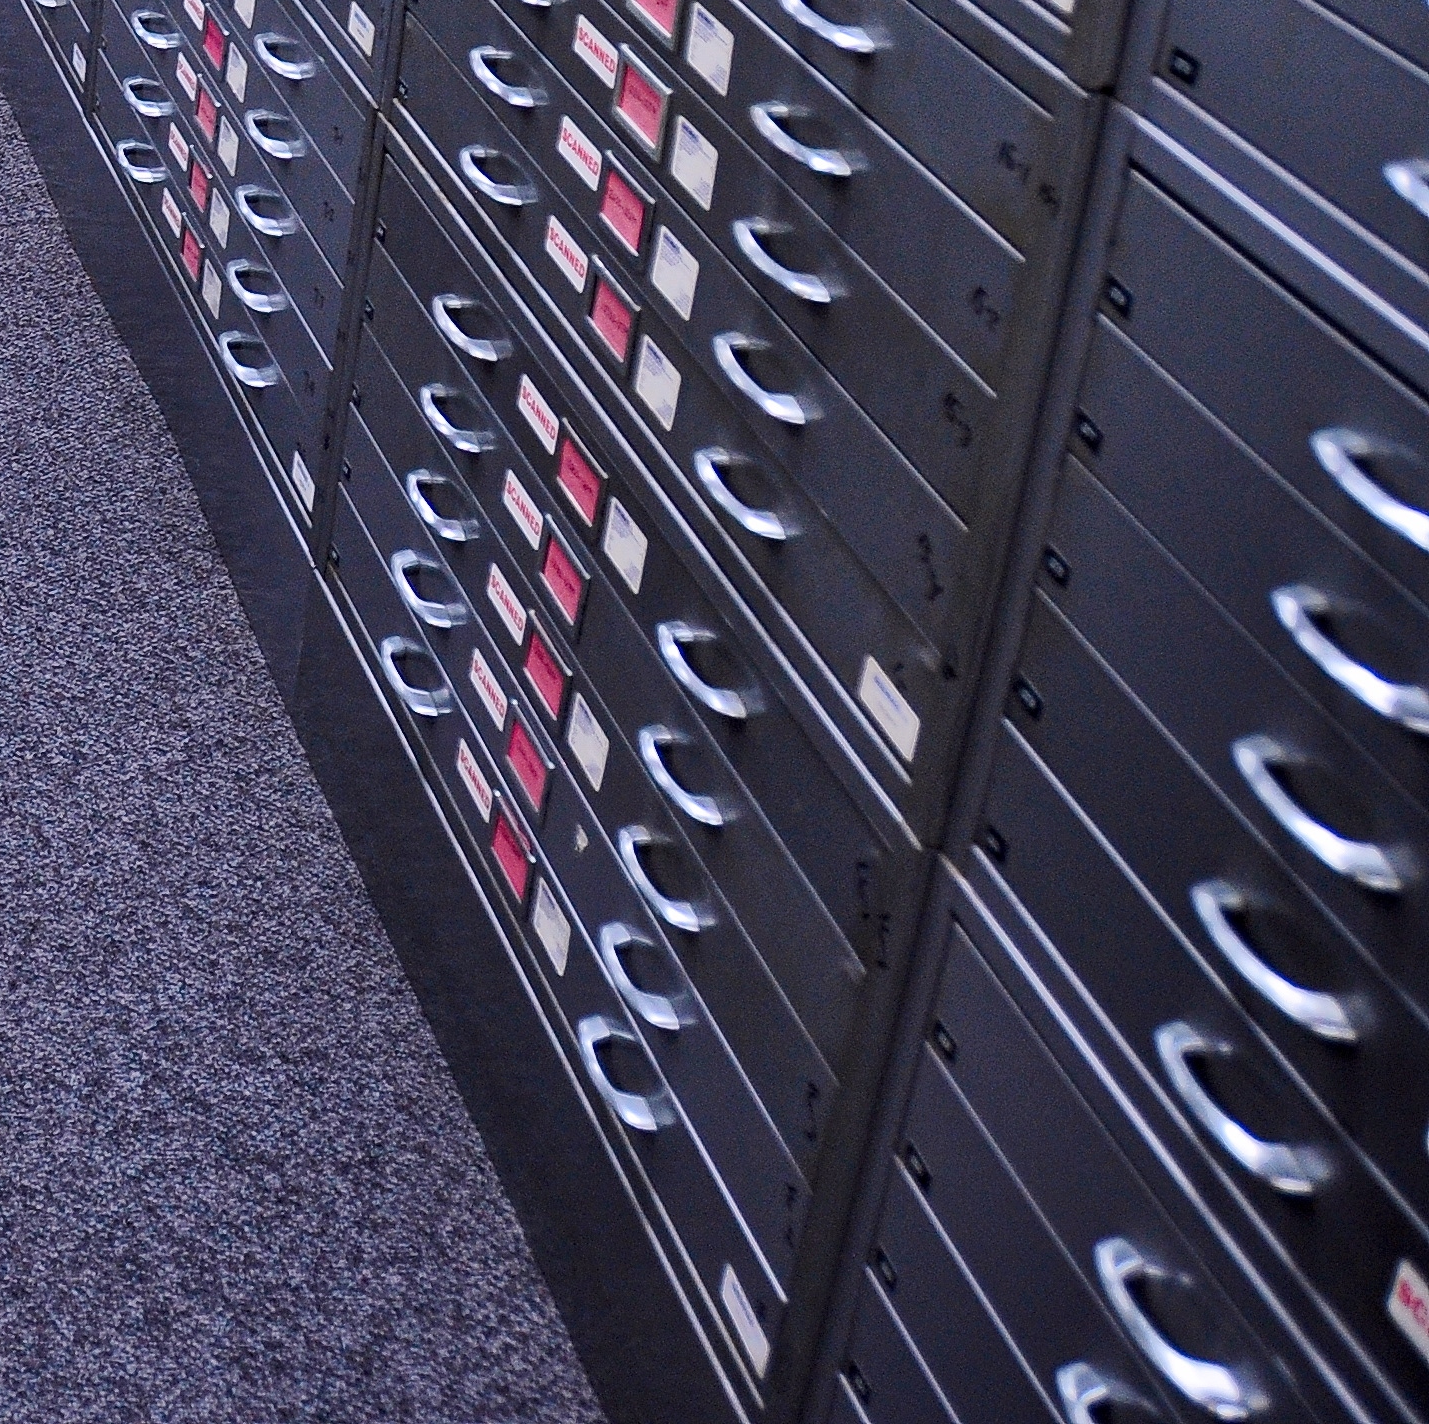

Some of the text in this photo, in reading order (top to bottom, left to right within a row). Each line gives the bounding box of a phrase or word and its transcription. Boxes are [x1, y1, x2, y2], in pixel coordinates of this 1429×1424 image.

[578, 27, 616, 74] SCANNED
[561, 127, 599, 176] SCANNED
[549, 225, 586, 279] SCANNED
[521, 385, 556, 441] SCANNED
[507, 480, 541, 537] SCANNED
[491, 574, 524, 632] SCANNED
[473, 659, 505, 718] SCANNED
